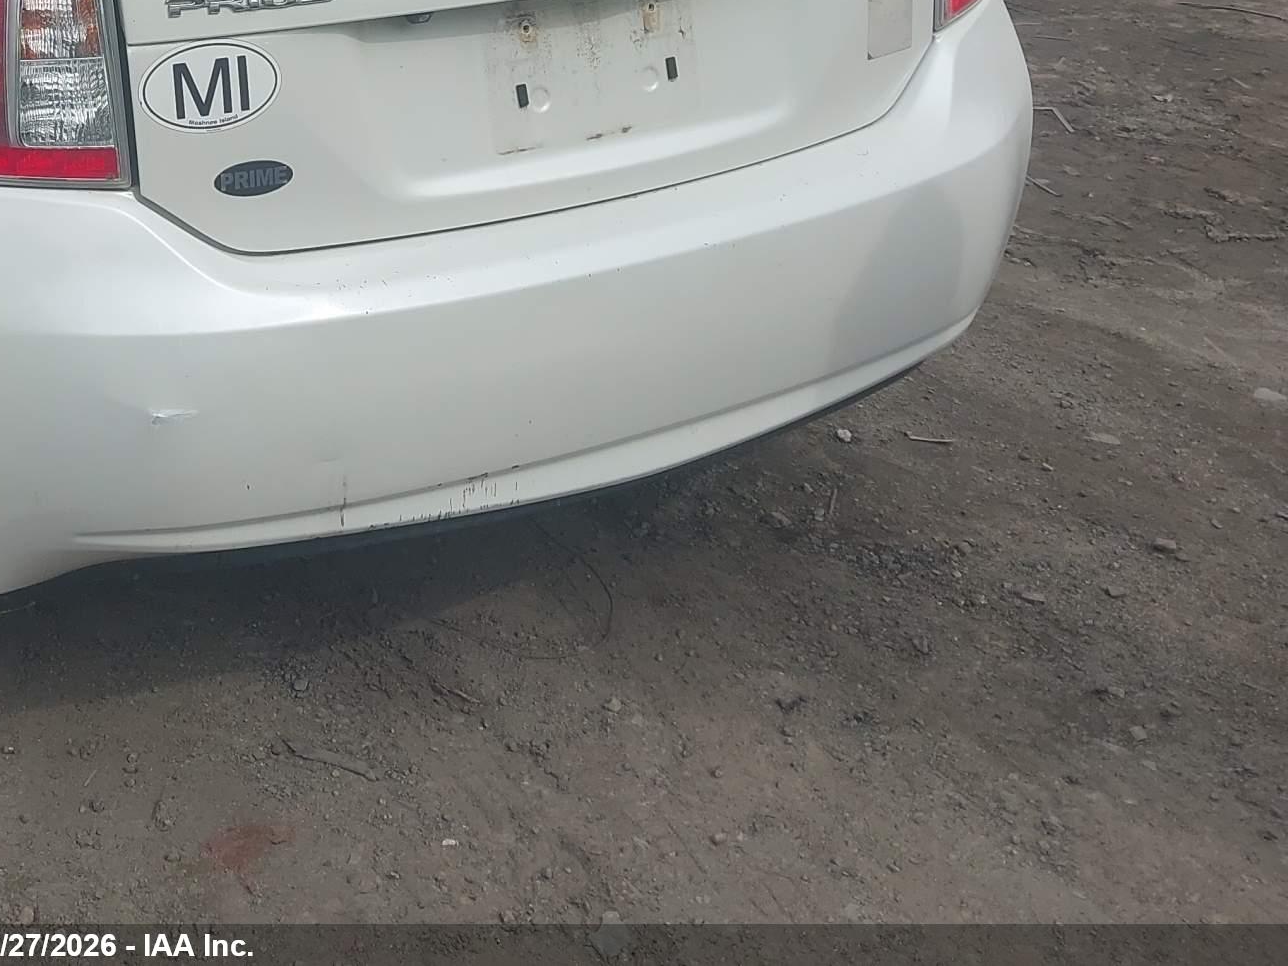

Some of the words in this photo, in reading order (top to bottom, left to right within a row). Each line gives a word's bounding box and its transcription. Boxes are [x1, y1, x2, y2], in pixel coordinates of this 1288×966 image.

[172, 55, 251, 120] MI
[219, 114, 239, 124] Island
[220, 165, 288, 192] PRIME
